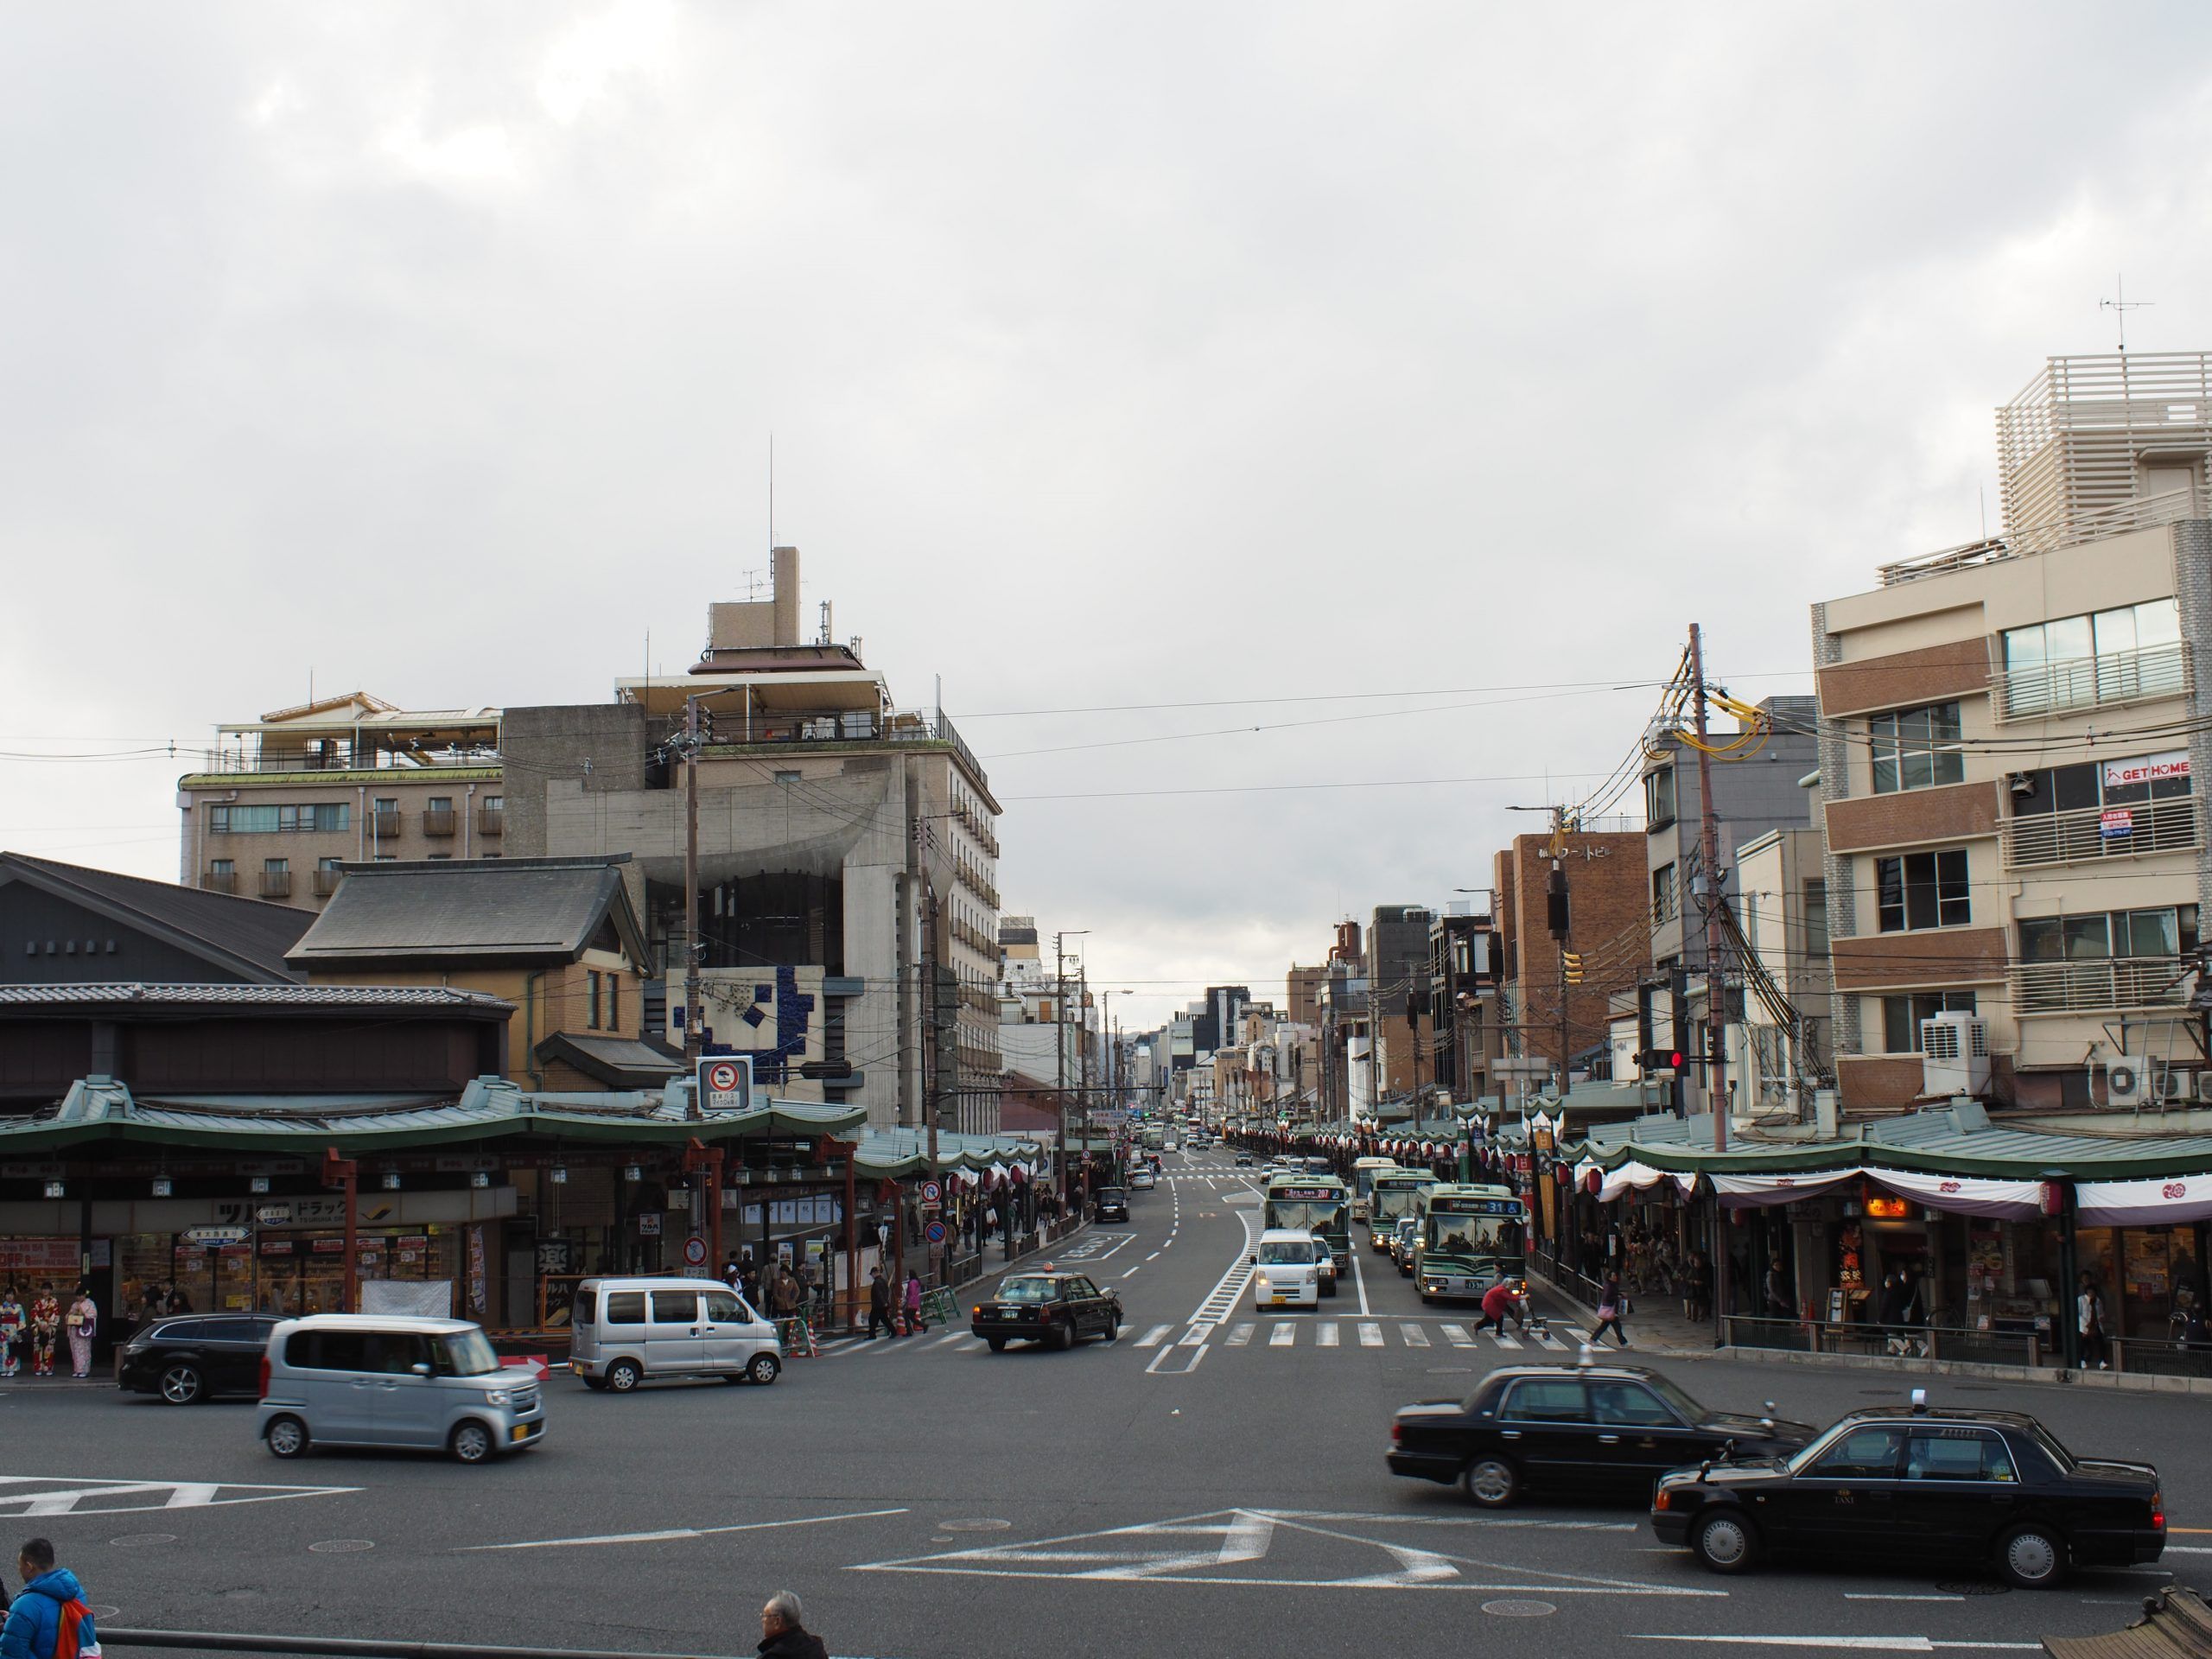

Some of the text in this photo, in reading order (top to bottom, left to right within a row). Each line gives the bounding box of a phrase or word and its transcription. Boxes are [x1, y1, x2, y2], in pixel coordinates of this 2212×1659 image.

[2122, 761, 2190, 780] GET HOME
[1318, 1189, 1329, 1198] 207
[1489, 1202, 1503, 1212] 31
[538, 1243, 568, 1274] 薬
[536, 1282, 569, 1294] ルハ
[1833, 1496, 1854, 1504] TAXI
